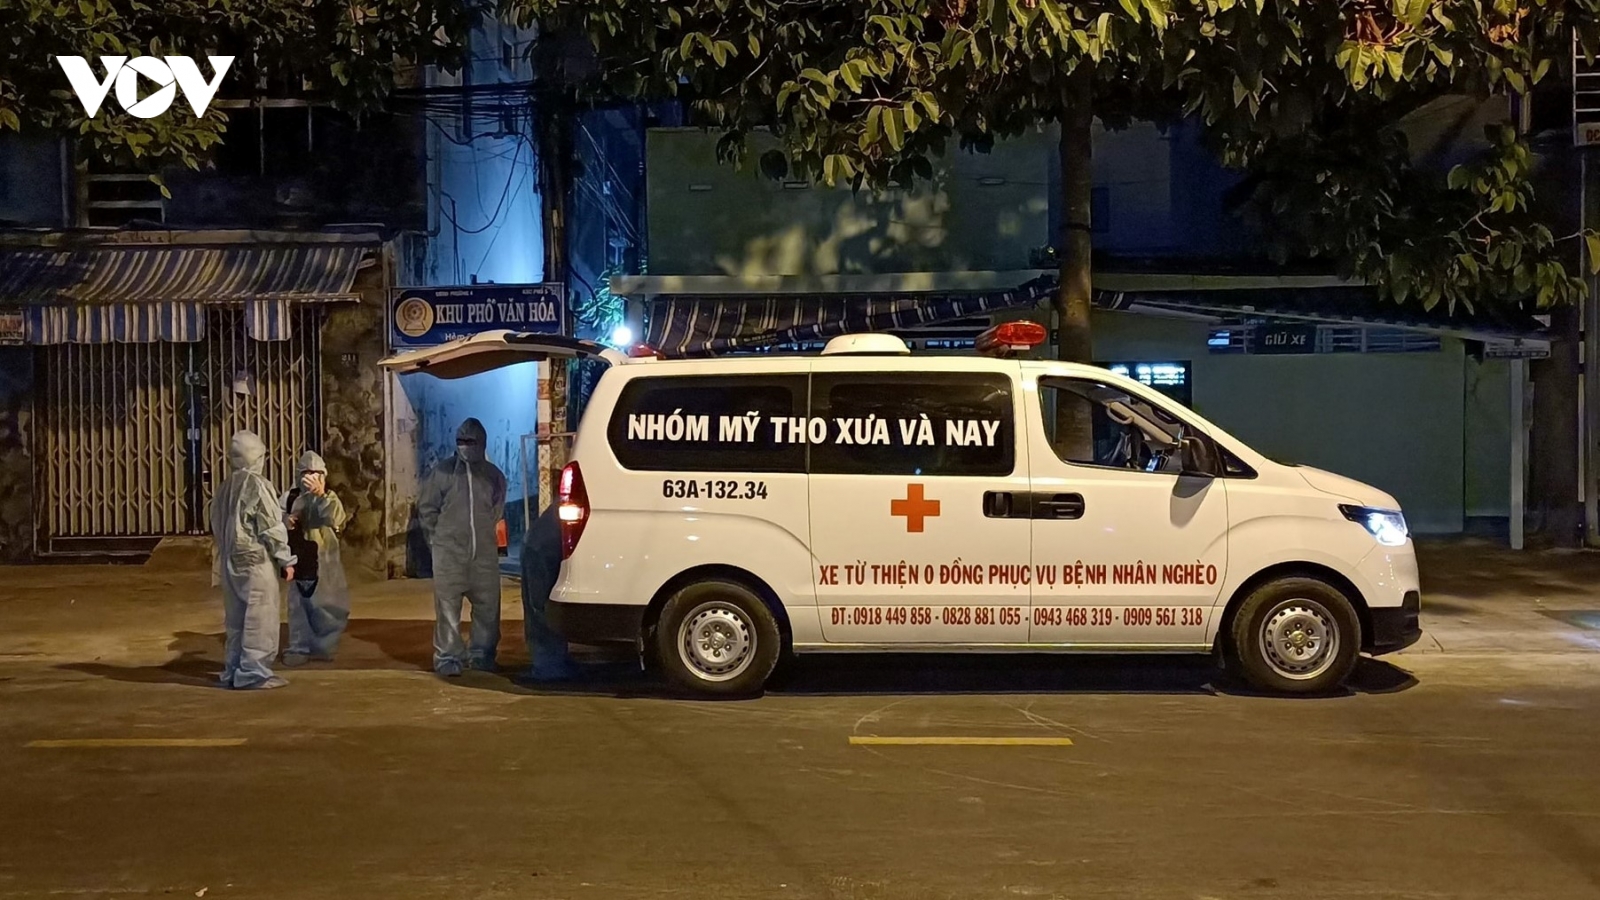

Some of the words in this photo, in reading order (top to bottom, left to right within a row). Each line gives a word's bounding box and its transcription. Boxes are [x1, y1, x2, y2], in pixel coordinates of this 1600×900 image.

[435, 303, 464, 324] KHU
[497, 298, 525, 323] VĂN
[529, 296, 558, 322] HÓA
[627, 408, 709, 442] NHÓM
[719, 410, 761, 443] MỸ
[770, 417, 828, 445] THO
[835, 413, 890, 445] XƯA
[899, 413, 935, 446] VÀ
[946, 419, 1000, 447] NAY
[663, 479, 768, 500] 63A-132.34
[819, 565, 839, 586] XE
[844, 560, 867, 586] TỪ
[871, 560, 919, 589] THIỆN
[939, 557, 983, 586] ĐỒNG
[988, 564, 1031, 589] PHỤC
[1036, 564, 1056, 590] VỤ
[1063, 560, 1107, 589] BỆNH
[1113, 560, 1157, 585] NHÂN
[1162, 559, 1217, 586] NGHÈO
[885, 607, 907, 625] 449
[910, 607, 932, 625] 858
[943, 607, 971, 626] 0828
[974, 607, 995, 625] 881
[1000, 607, 1021, 625] 055
[1033, 608, 1062, 626] 0943
[1065, 608, 1087, 626] 468
[1091, 608, 1112, 626] 319
[1123, 608, 1152, 626] 0909
[1156, 608, 1177, 626] 561
[1181, 608, 1203, 626] 318
